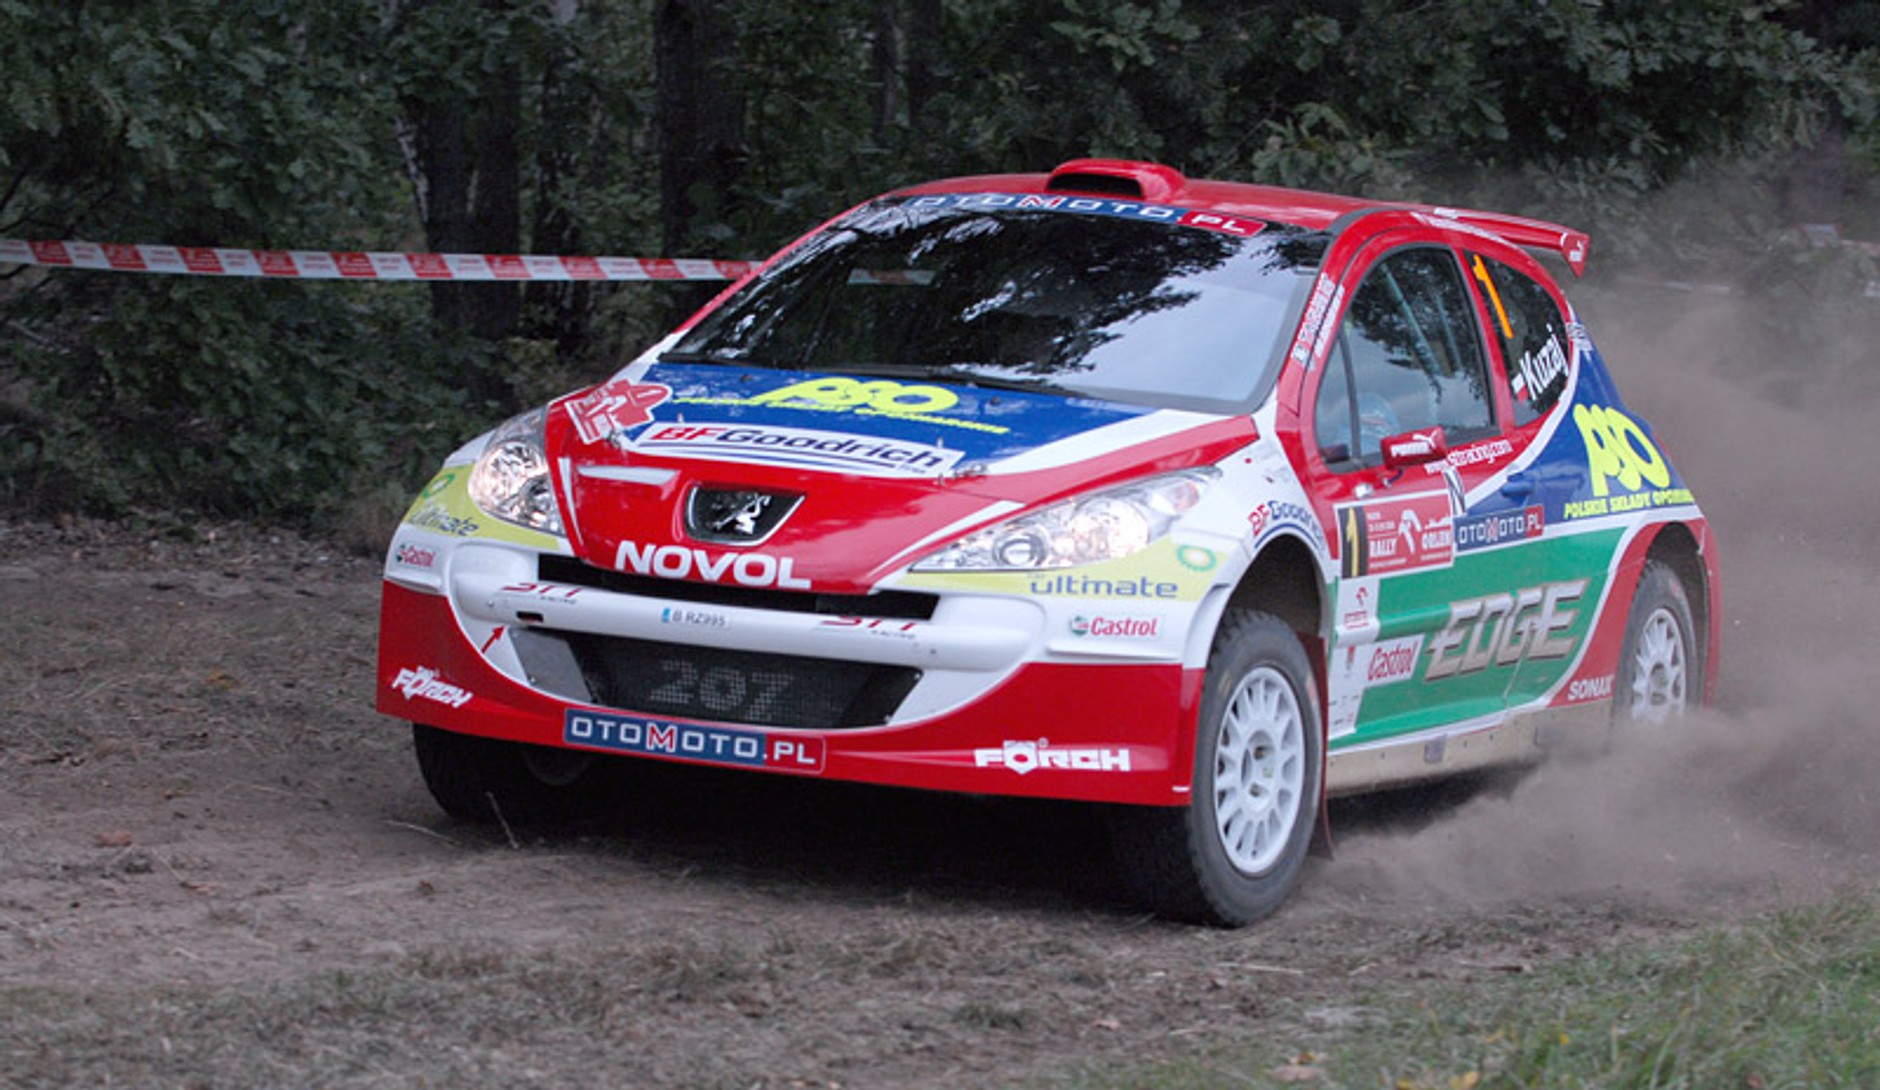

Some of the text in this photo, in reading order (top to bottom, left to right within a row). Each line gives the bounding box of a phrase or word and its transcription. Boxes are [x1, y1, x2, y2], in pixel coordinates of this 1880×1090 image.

[1473, 254, 1514, 339] 1
[650, 426, 943, 467] BFGoodrich
[1346, 507, 1359, 577] 1
[1458, 513, 1542, 544] OTOMOTO.PL
[614, 540, 812, 589] NOVOL
[1030, 575, 1178, 598] ultimate
[1090, 616, 1158, 636] Castrol
[1425, 578, 1592, 683] EDGE
[1367, 640, 1419, 681] Castrol
[651, 659, 795, 722] 207
[570, 716, 817, 765] OTOMOTO.PL
